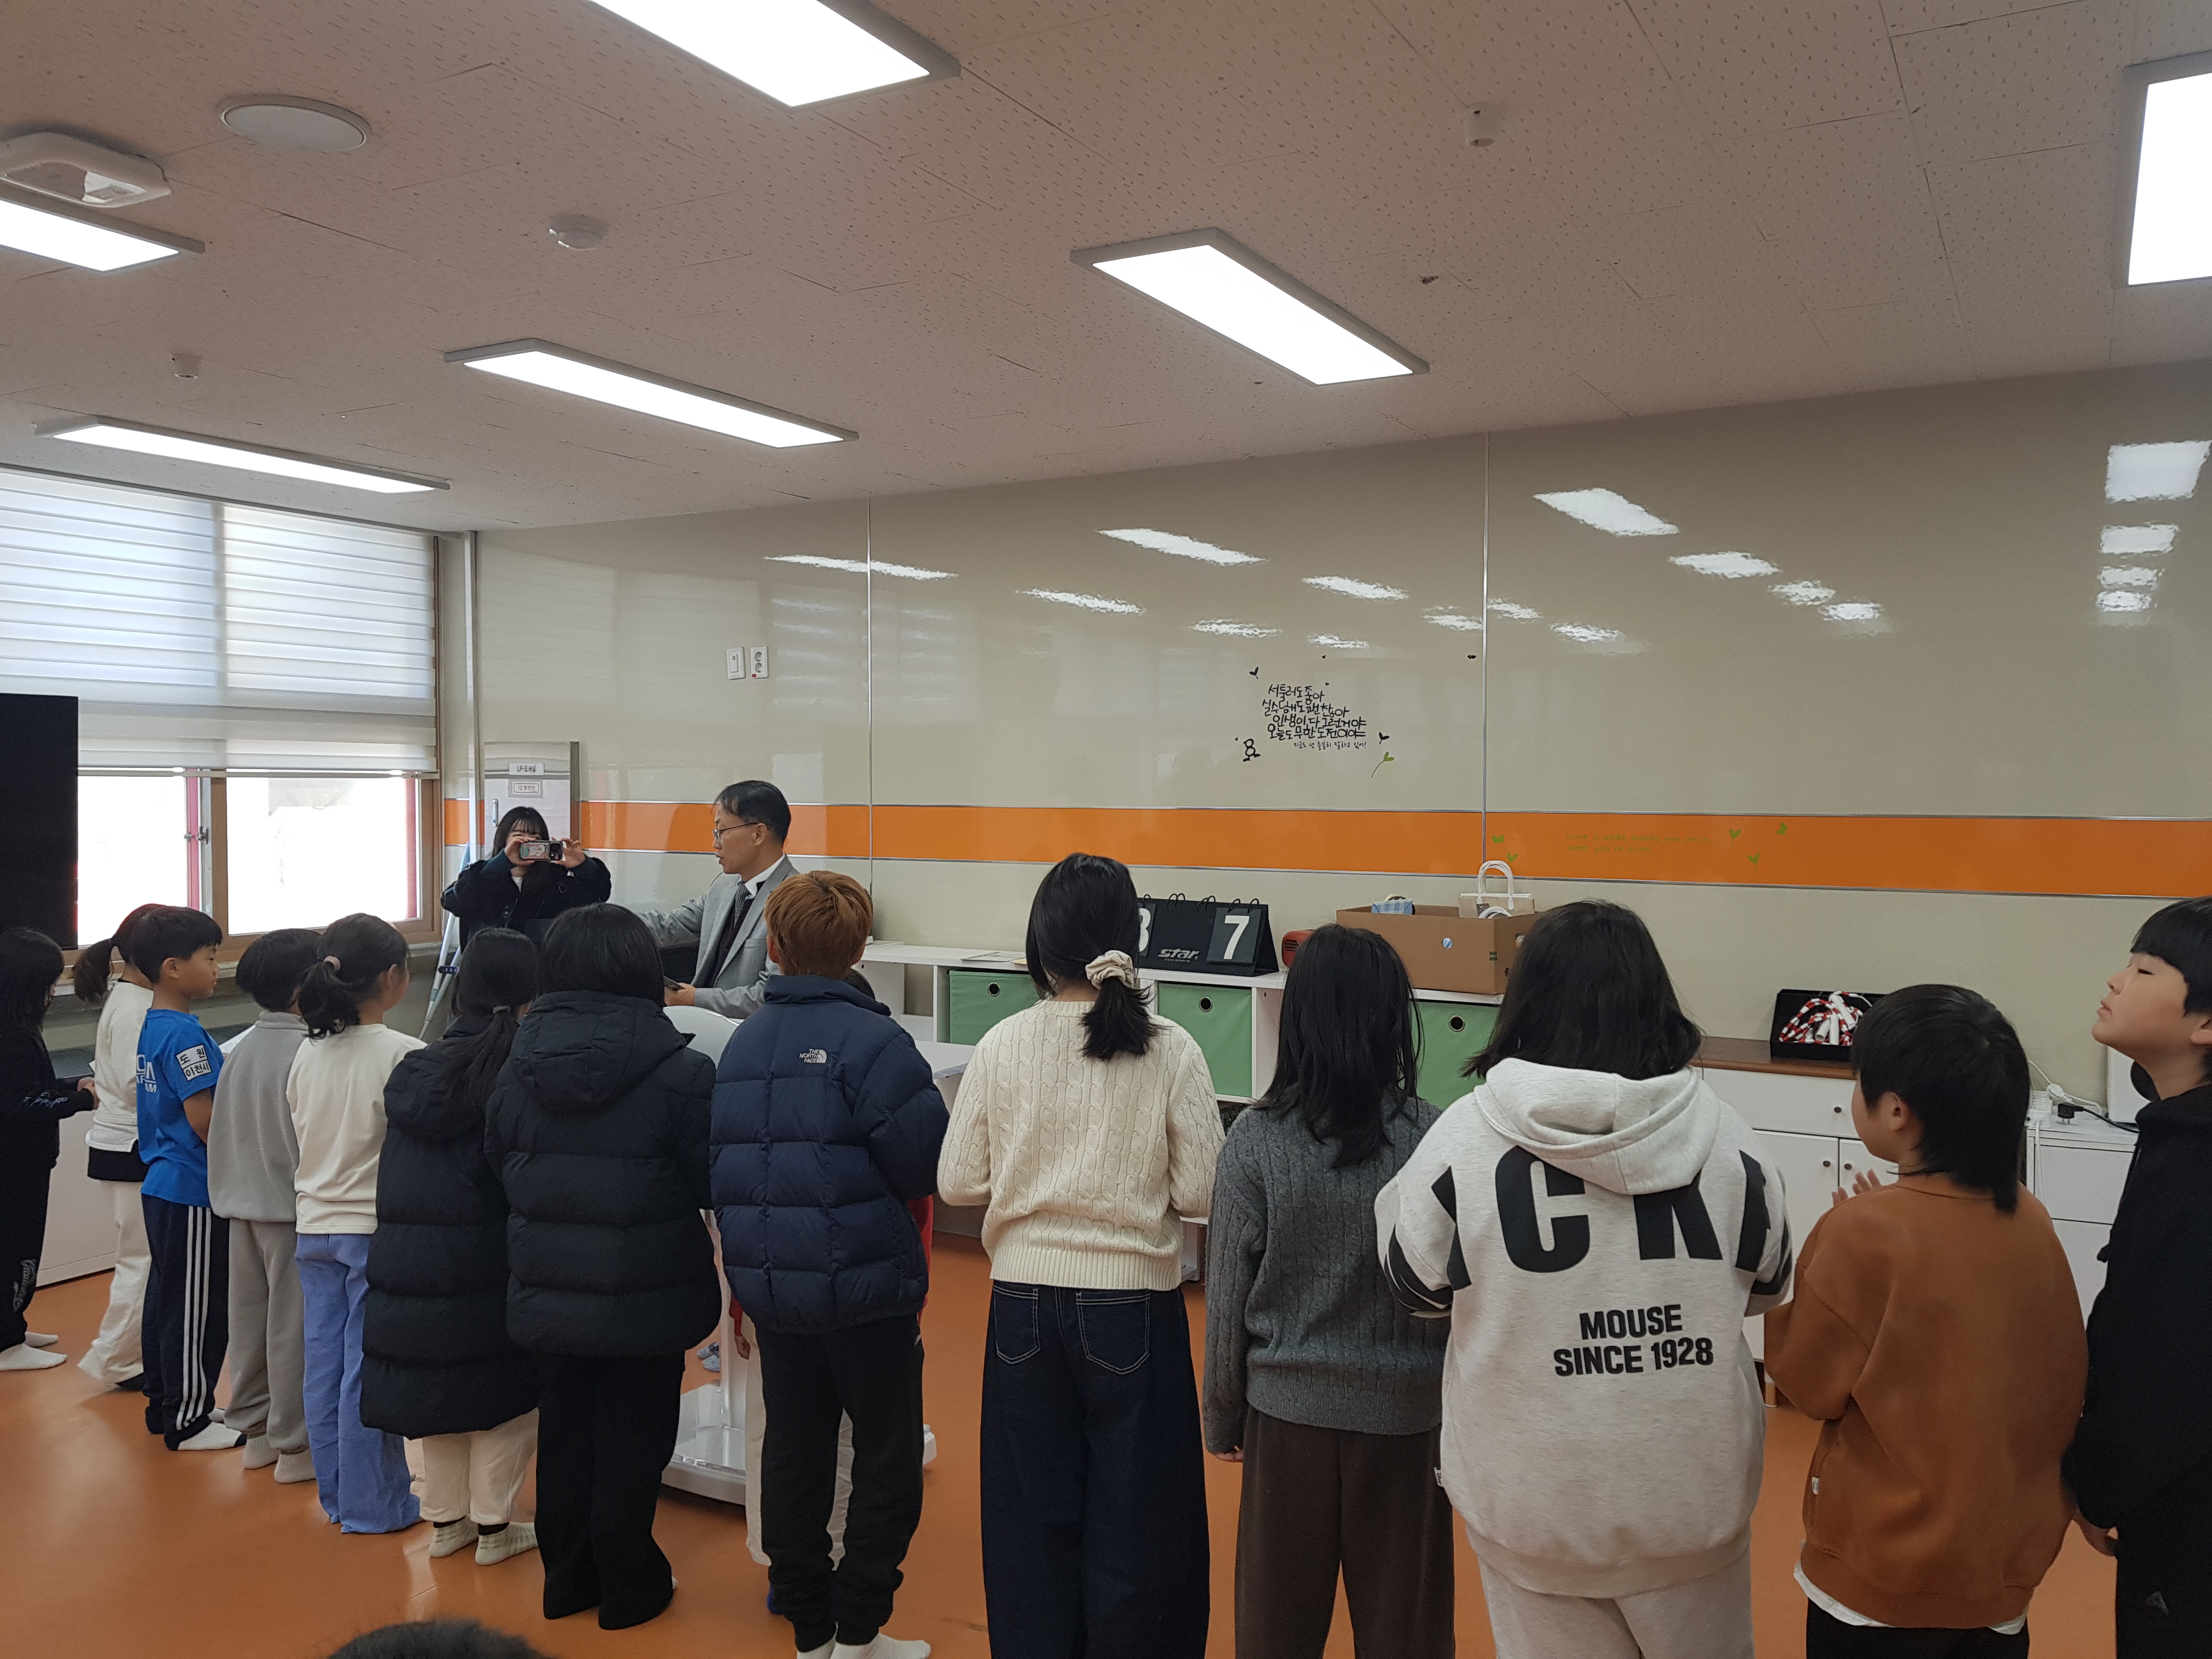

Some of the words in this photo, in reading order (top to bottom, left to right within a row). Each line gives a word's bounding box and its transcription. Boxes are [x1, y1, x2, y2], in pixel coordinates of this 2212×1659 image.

[1268, 684, 1303, 707] 서툴러도
[1305, 686, 1325, 706] 좋아
[1262, 699, 1305, 716] 실수해도
[1306, 703, 1350, 718] 괜찮아
[1267, 723, 1293, 741] 오늘도
[1334, 741, 1351, 750] 잘하고
[1223, 915, 1250, 960] 7
[186, 1062, 209, 1076] 이천시
[1579, 1304, 1683, 1340] MOUSE
[1554, 1344, 1644, 1377] SINCE
[1650, 1336, 1714, 1371] 1928
